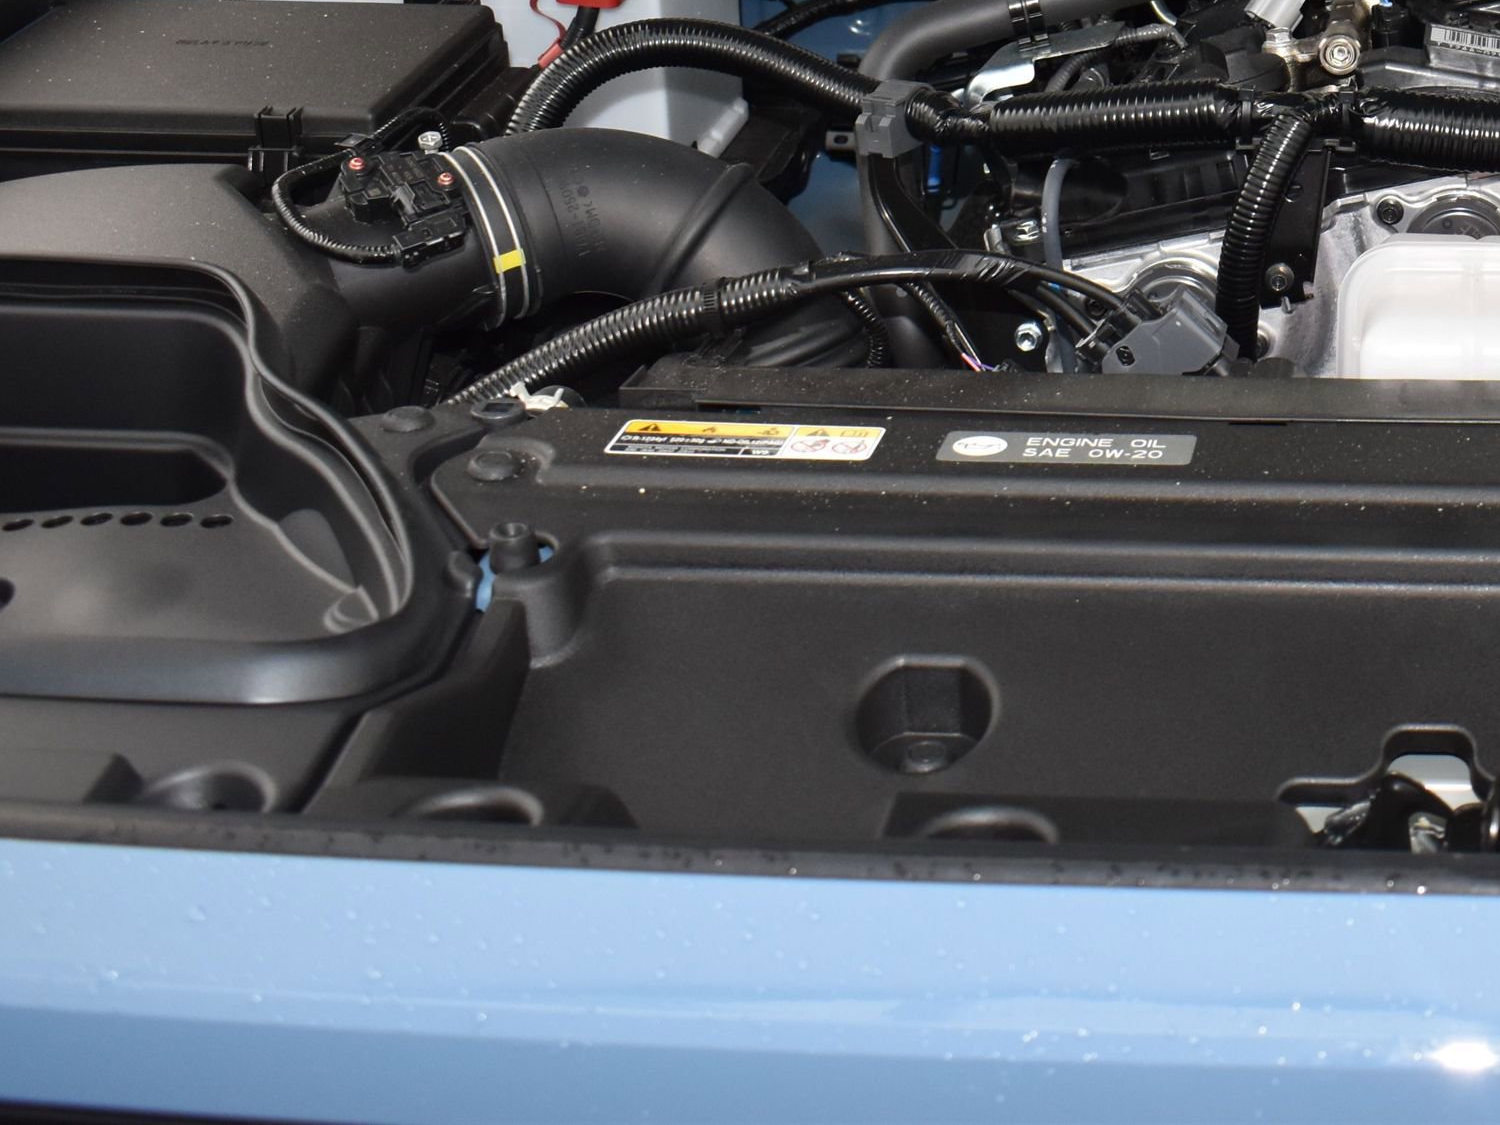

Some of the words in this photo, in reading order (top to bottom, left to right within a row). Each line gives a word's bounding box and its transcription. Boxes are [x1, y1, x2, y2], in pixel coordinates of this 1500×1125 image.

[1026, 437, 1114, 448] ENGINE
[1130, 438, 1166, 448] OIL
[1022, 448, 1071, 458] SAE
[1088, 449, 1163, 459] 0W-20
